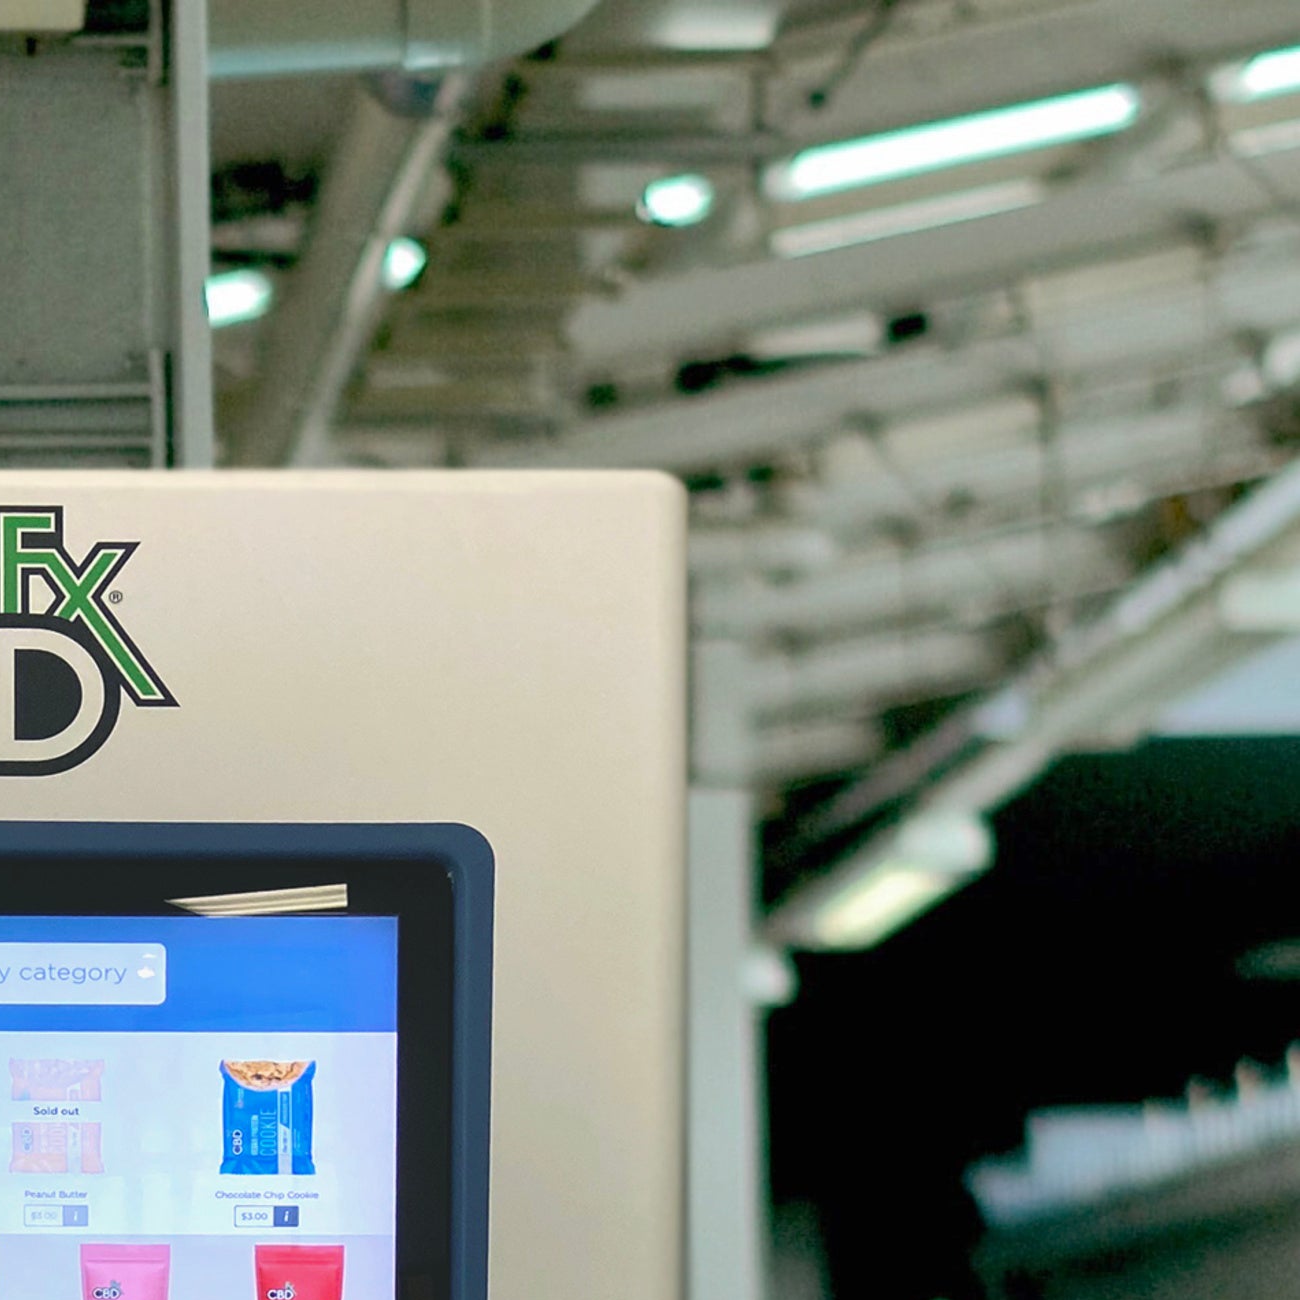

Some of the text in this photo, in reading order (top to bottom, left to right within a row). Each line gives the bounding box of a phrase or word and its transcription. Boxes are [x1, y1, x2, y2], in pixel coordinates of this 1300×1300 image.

[19, 965, 127, 984] category
[33, 1106, 79, 1115] Sold out
[215, 1191, 261, 1199] Chocolate
